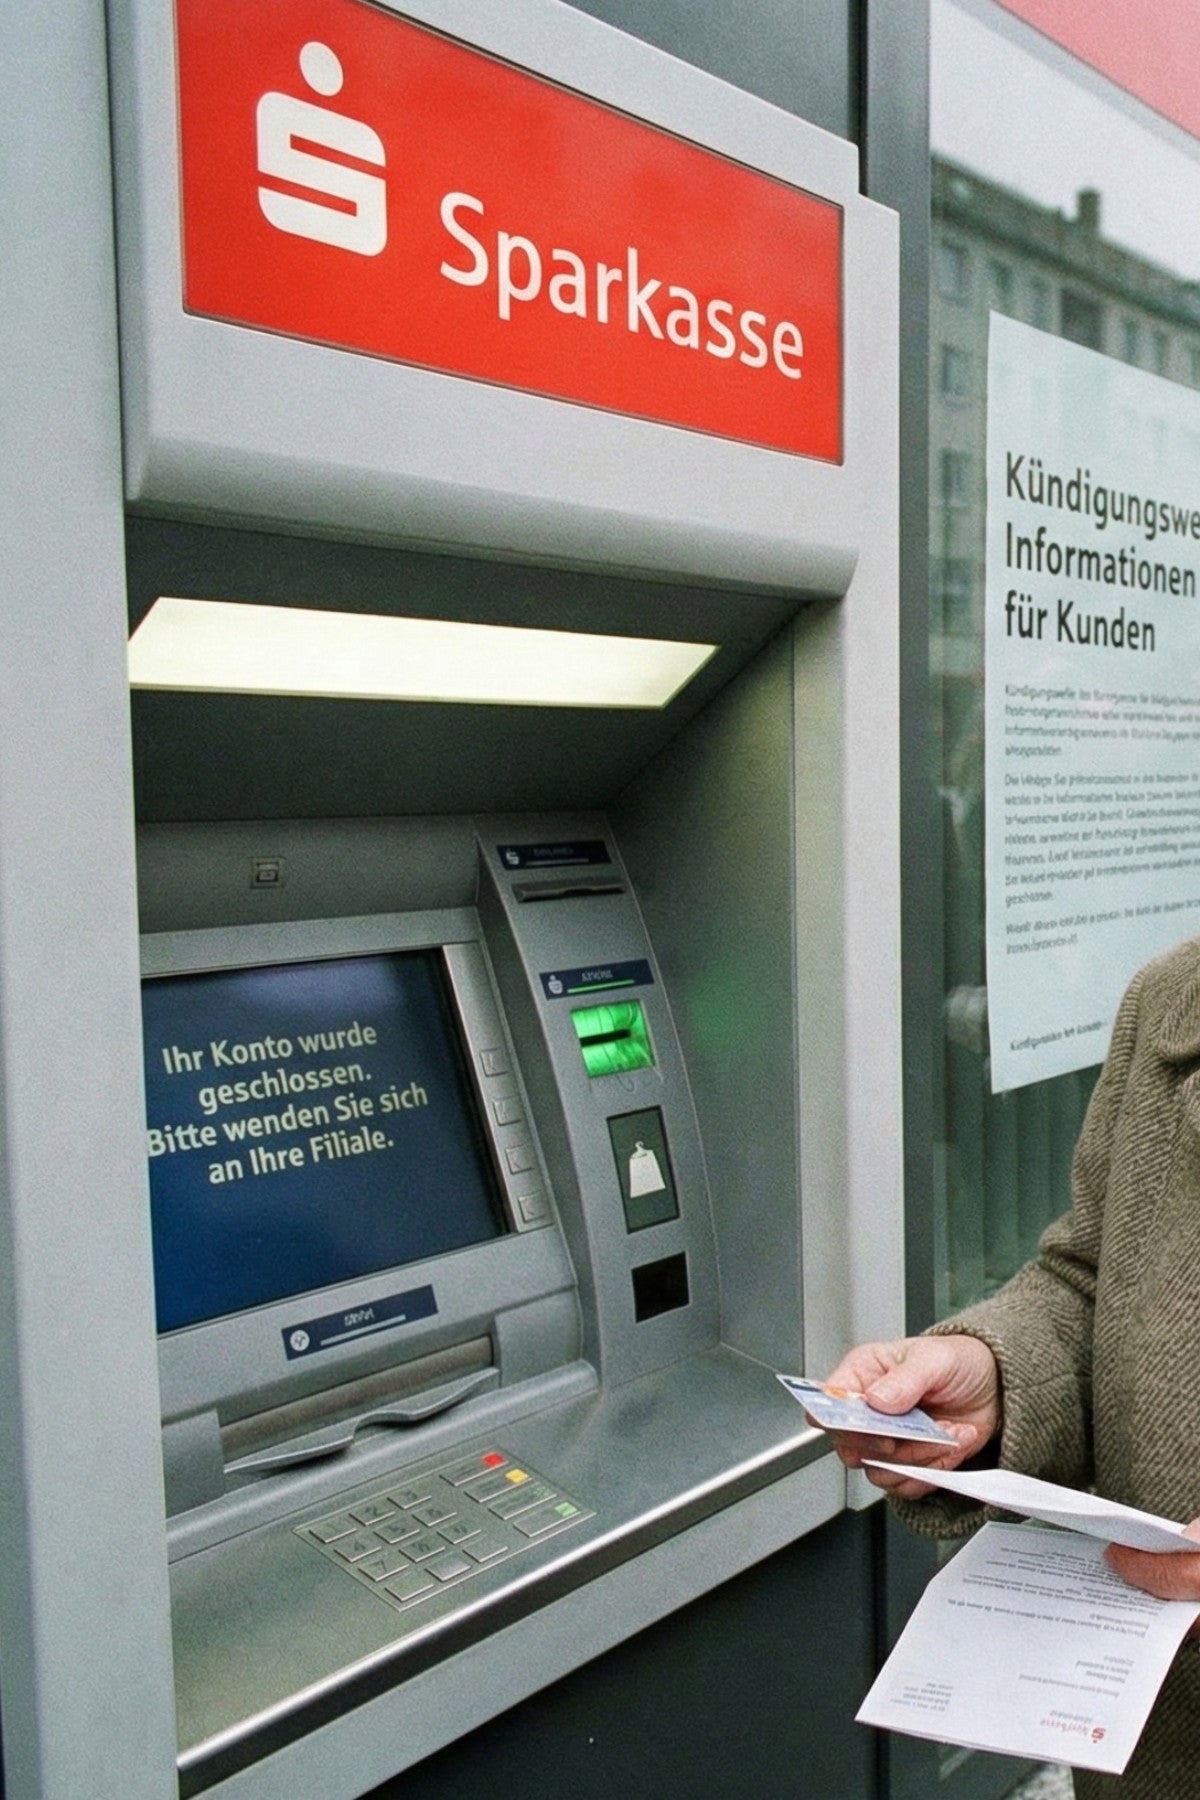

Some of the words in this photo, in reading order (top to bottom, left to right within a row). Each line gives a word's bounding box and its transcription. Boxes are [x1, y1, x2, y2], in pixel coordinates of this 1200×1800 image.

[439, 191, 805, 380] Sparkasse
[1006, 522, 1197, 598] Informationen
[1005, 590, 1047, 640] für
[1057, 599, 1156, 652] Kunden
[162, 1046, 204, 1074] Ihr
[210, 1035, 293, 1068] Konto
[298, 1021, 378, 1054] wurde
[147, 1122, 217, 1157] Bitte
[222, 1104, 330, 1142] wenden
[334, 1092, 374, 1120] Sie
[380, 1082, 429, 1113] sich
[198, 1062, 372, 1116] geschlossen.
[208, 1158, 244, 1184] an
[249, 1146, 304, 1176] Ihre
[310, 1126, 394, 1163] Filiale.
